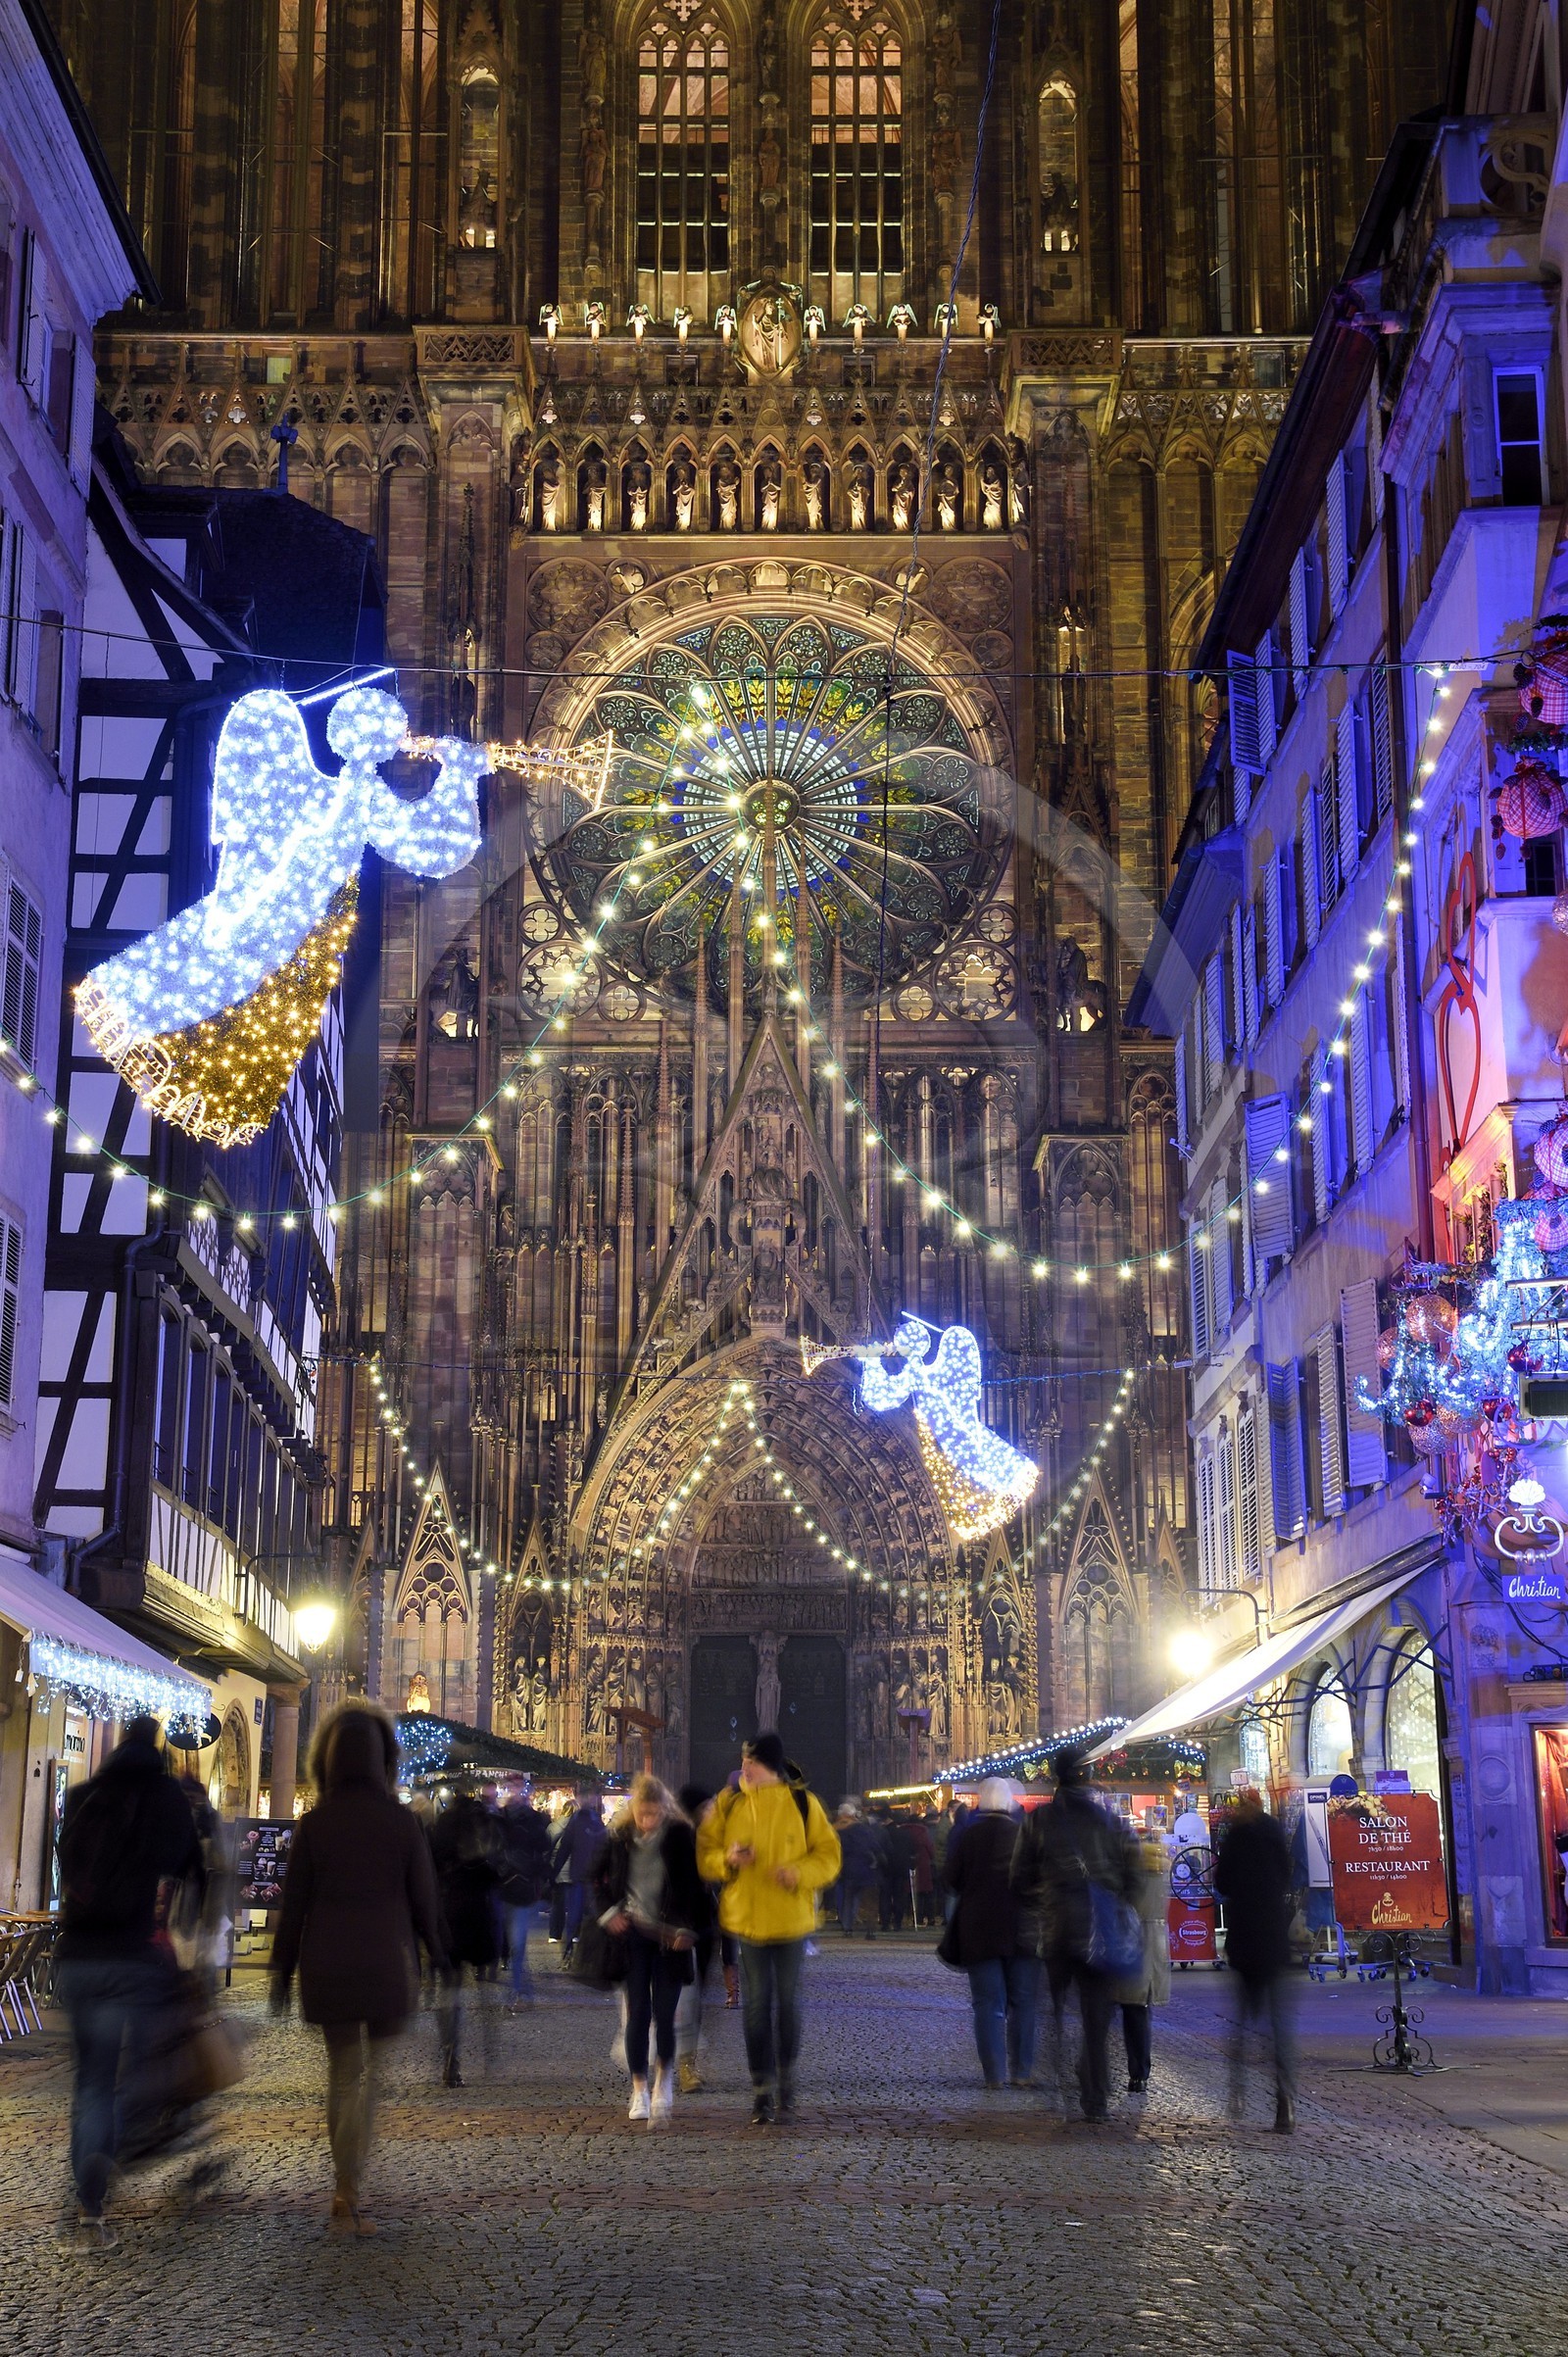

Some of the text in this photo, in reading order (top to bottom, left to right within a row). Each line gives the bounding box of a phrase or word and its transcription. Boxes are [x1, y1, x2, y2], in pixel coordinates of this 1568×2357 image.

[1509, 1576, 1561, 1599] Christian
[1359, 1816, 1407, 1829] SALON
[1358, 1830, 1412, 1844] DE THÉ
[1346, 1860, 1430, 1873] RESTAURANT
[1372, 1900, 1412, 1925] Christian
